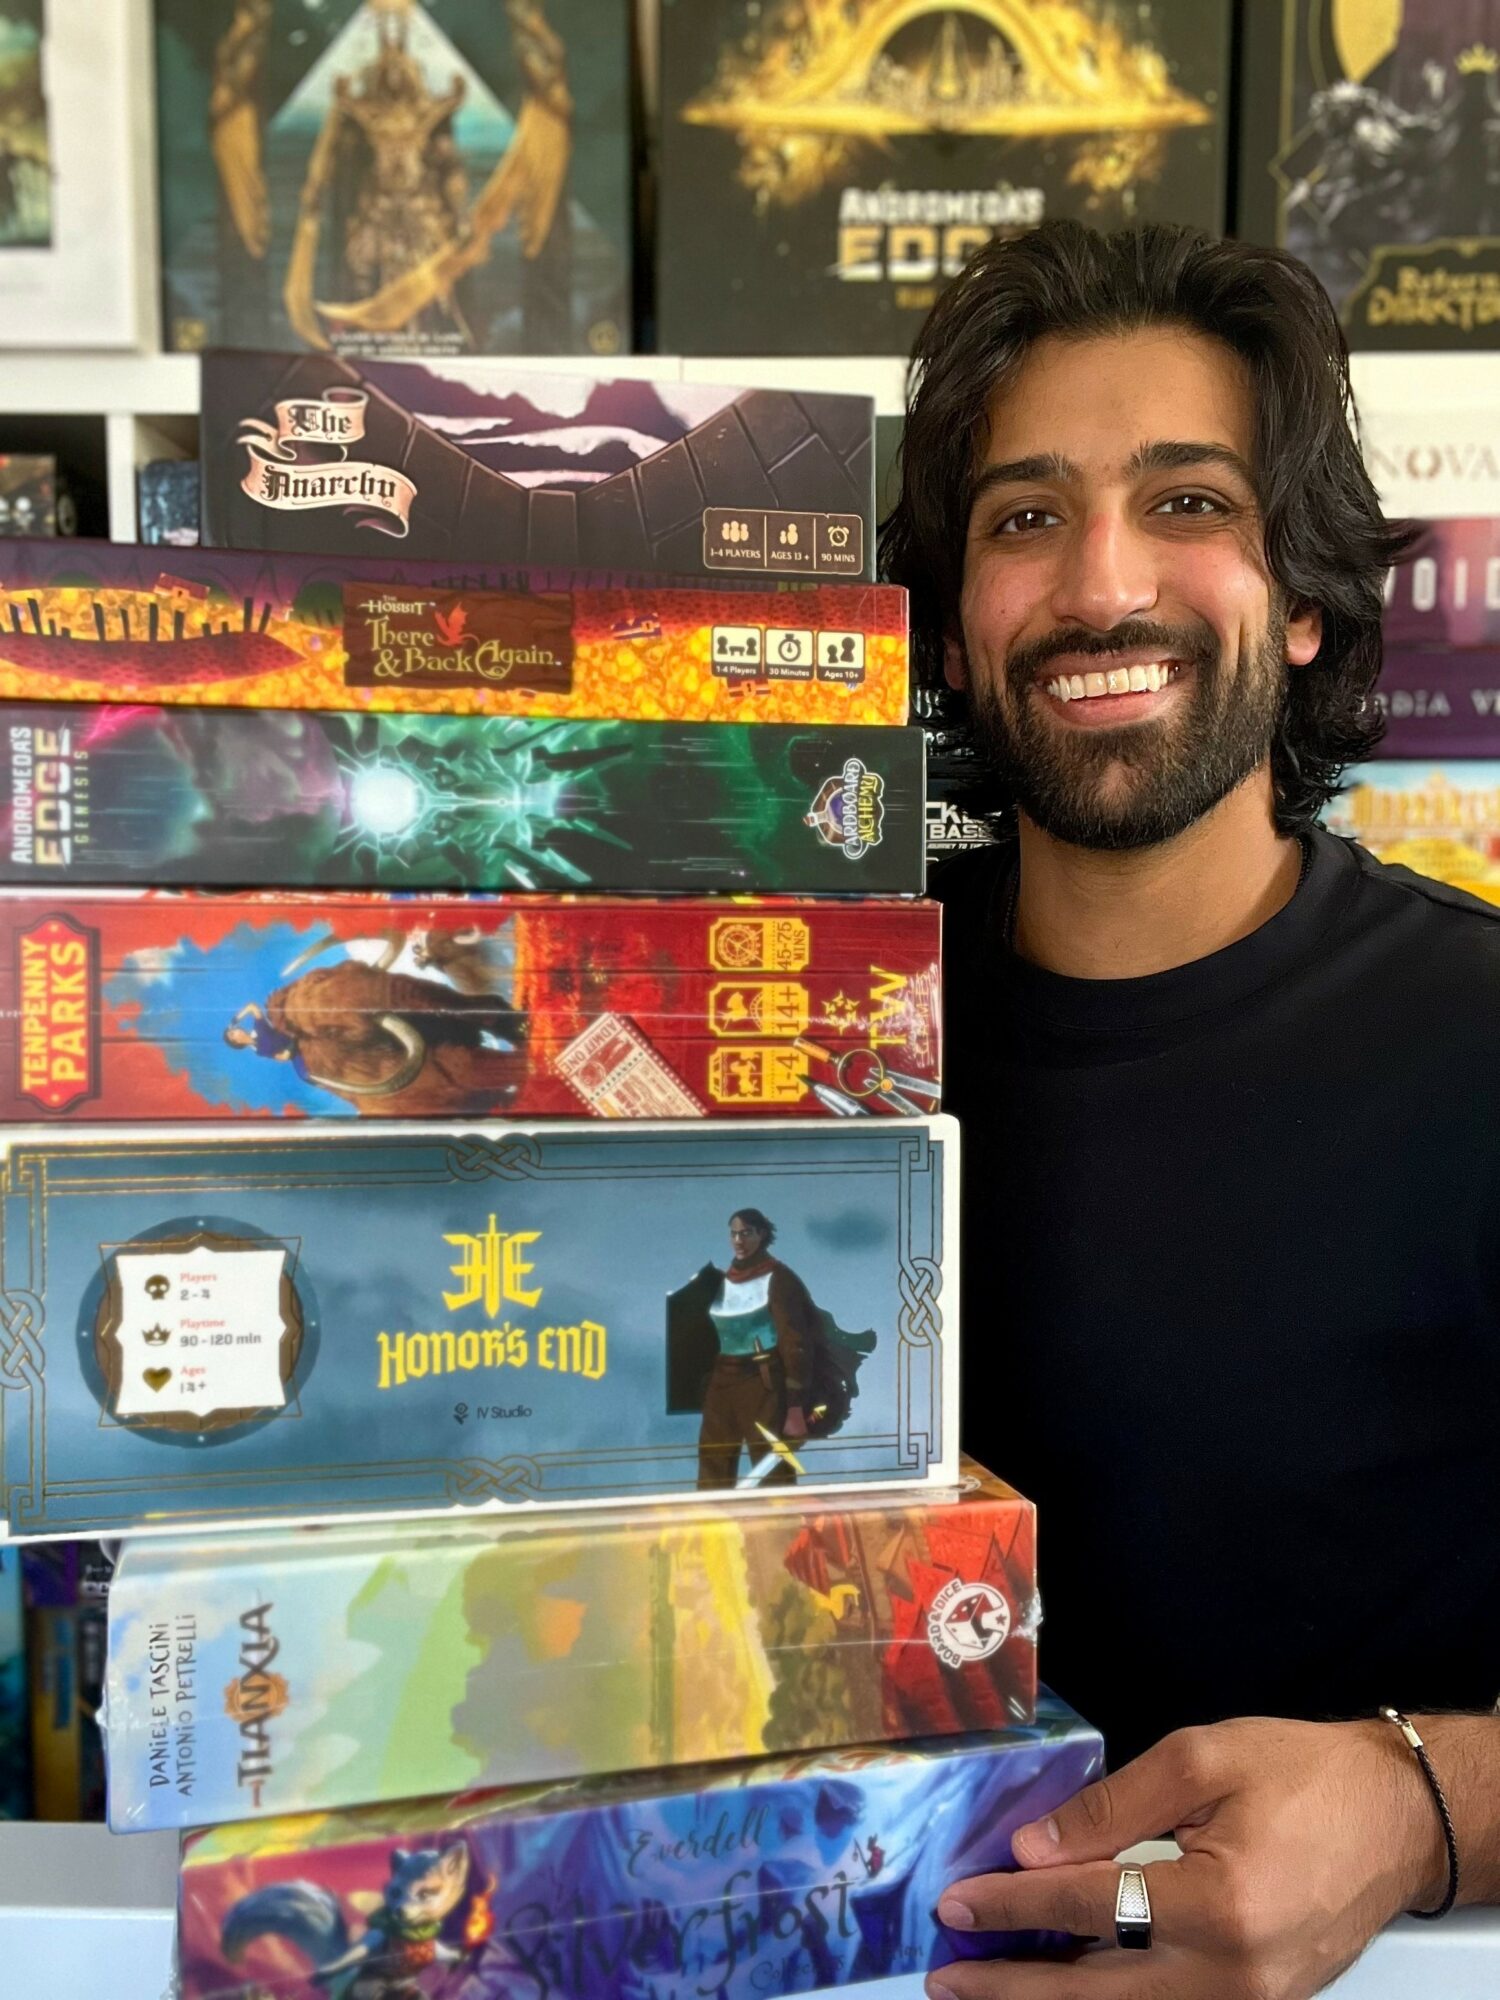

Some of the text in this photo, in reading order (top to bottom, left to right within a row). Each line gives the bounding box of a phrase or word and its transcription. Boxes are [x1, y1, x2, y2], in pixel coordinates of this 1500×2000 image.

[835, 226, 993, 281] EDG
[288, 404, 353, 440] The
[260, 465, 397, 507] Anarchy
[710, 548, 761, 559] 1-4 PLAYERS
[771, 551, 792, 560] AGES
[821, 554, 856, 563] 90 MINS
[359, 600, 427, 616] HOBBIT
[364, 615, 434, 652] There
[373, 639, 554, 680] & Back Again
[729, 665, 757, 675] Players
[781, 668, 810, 677] Minutes
[825, 670, 859, 679] Ages 10+
[10, 727, 33, 864] ANDROMEDA'S
[34, 727, 71, 866] EDGE
[74, 751, 89, 844] GENESIS
[842, 761, 863, 857] CARDBOARD
[858, 775, 878, 842] ALCHEMY
[776, 921, 793, 970] 45-75
[793, 929, 806, 961] MINS
[21, 937, 48, 1091] TENPENNY
[51, 941, 87, 1081] PARKS
[776, 986, 800, 1033] 14+
[560, 1017, 620, 1076] ADMIT ONE
[776, 1053, 800, 1095] 1-4
[180, 1272, 218, 1283] Players
[180, 1317, 226, 1330] Playtime
[236, 1332, 262, 1344] min
[180, 1365, 207, 1378] Ages
[376, 1319, 607, 1389] HONOR'S END
[477, 1404, 533, 1419] IV Studio
[934, 1580, 963, 1612] DICE
[930, 1623, 961, 1666] BOARD
[238, 1602, 280, 1790] TIANXIA
[622, 1804, 770, 1878] Everdell
